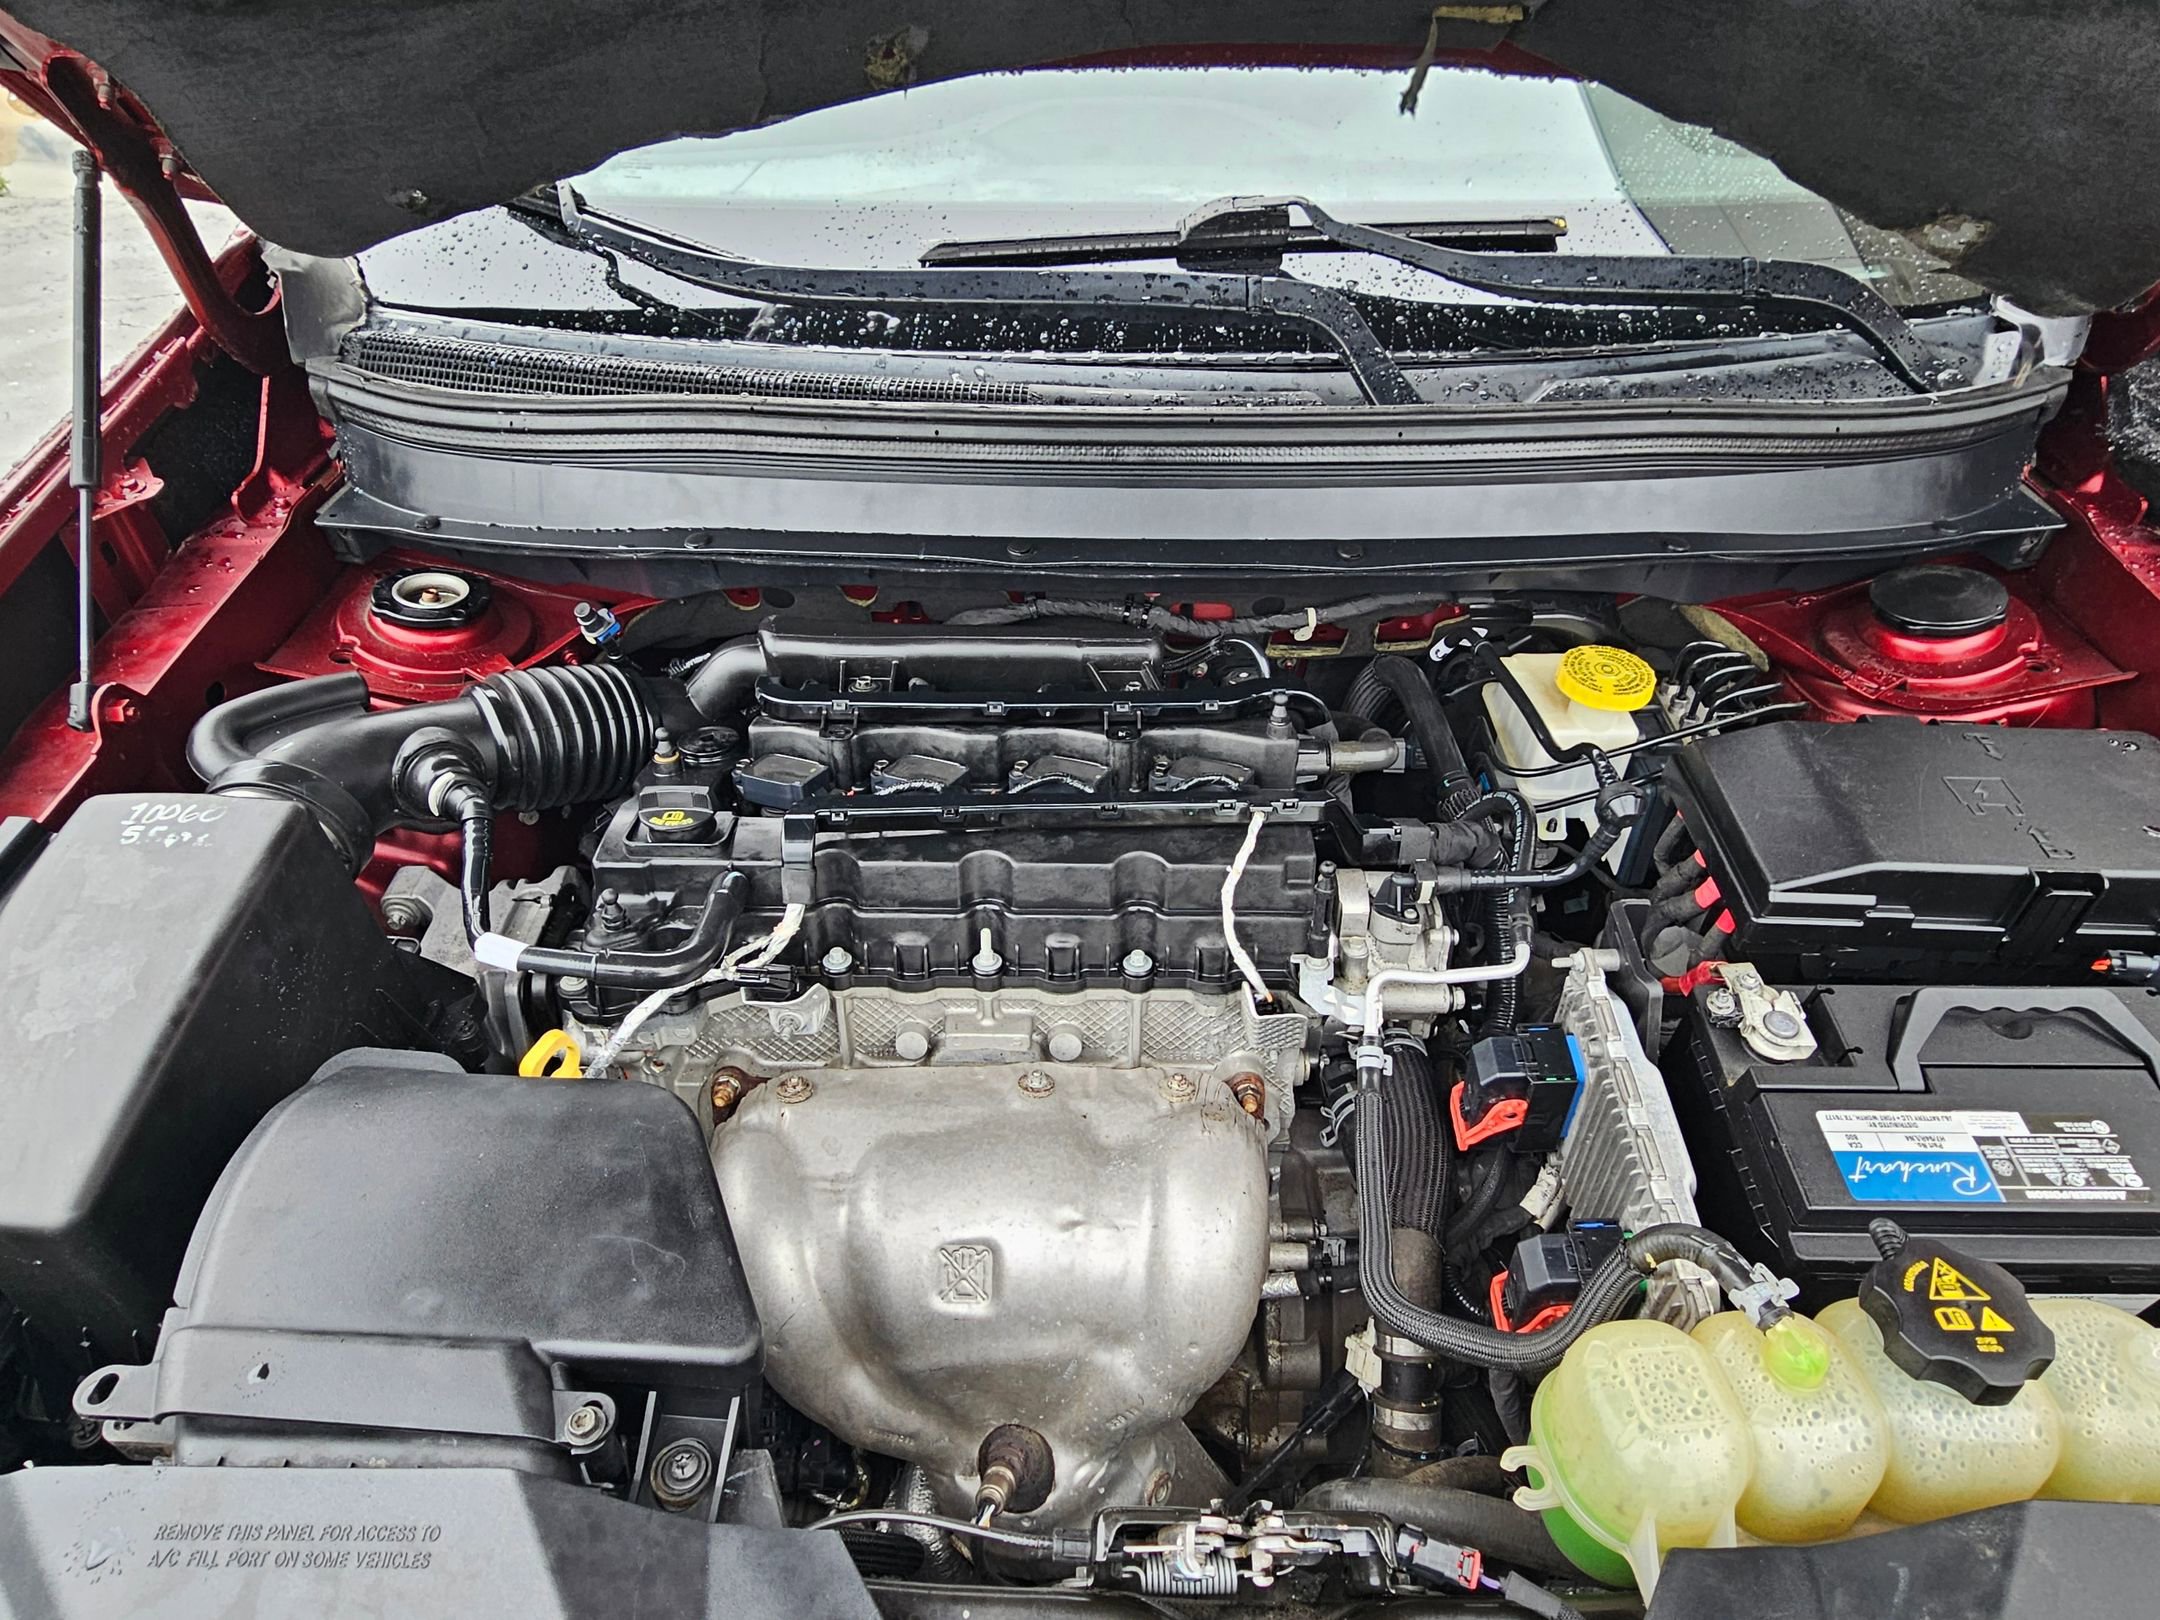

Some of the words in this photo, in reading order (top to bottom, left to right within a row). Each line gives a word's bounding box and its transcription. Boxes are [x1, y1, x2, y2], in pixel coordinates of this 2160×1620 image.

[1848, 1156, 1991, 1196] Rinehart
[153, 1523, 223, 1542] REMOVE
[226, 1523, 263, 1542] THIS
[264, 1524, 316, 1542] PANEL
[318, 1524, 352, 1542] FOR
[353, 1525, 416, 1542] ACCESS
[419, 1525, 441, 1543] TO
[147, 1548, 181, 1568] A/C
[186, 1550, 220, 1569] FILL
[225, 1550, 269, 1568] PORT
[274, 1551, 300, 1568] ON
[302, 1551, 350, 1569] SOME
[355, 1551, 432, 1569] VEHICLES
